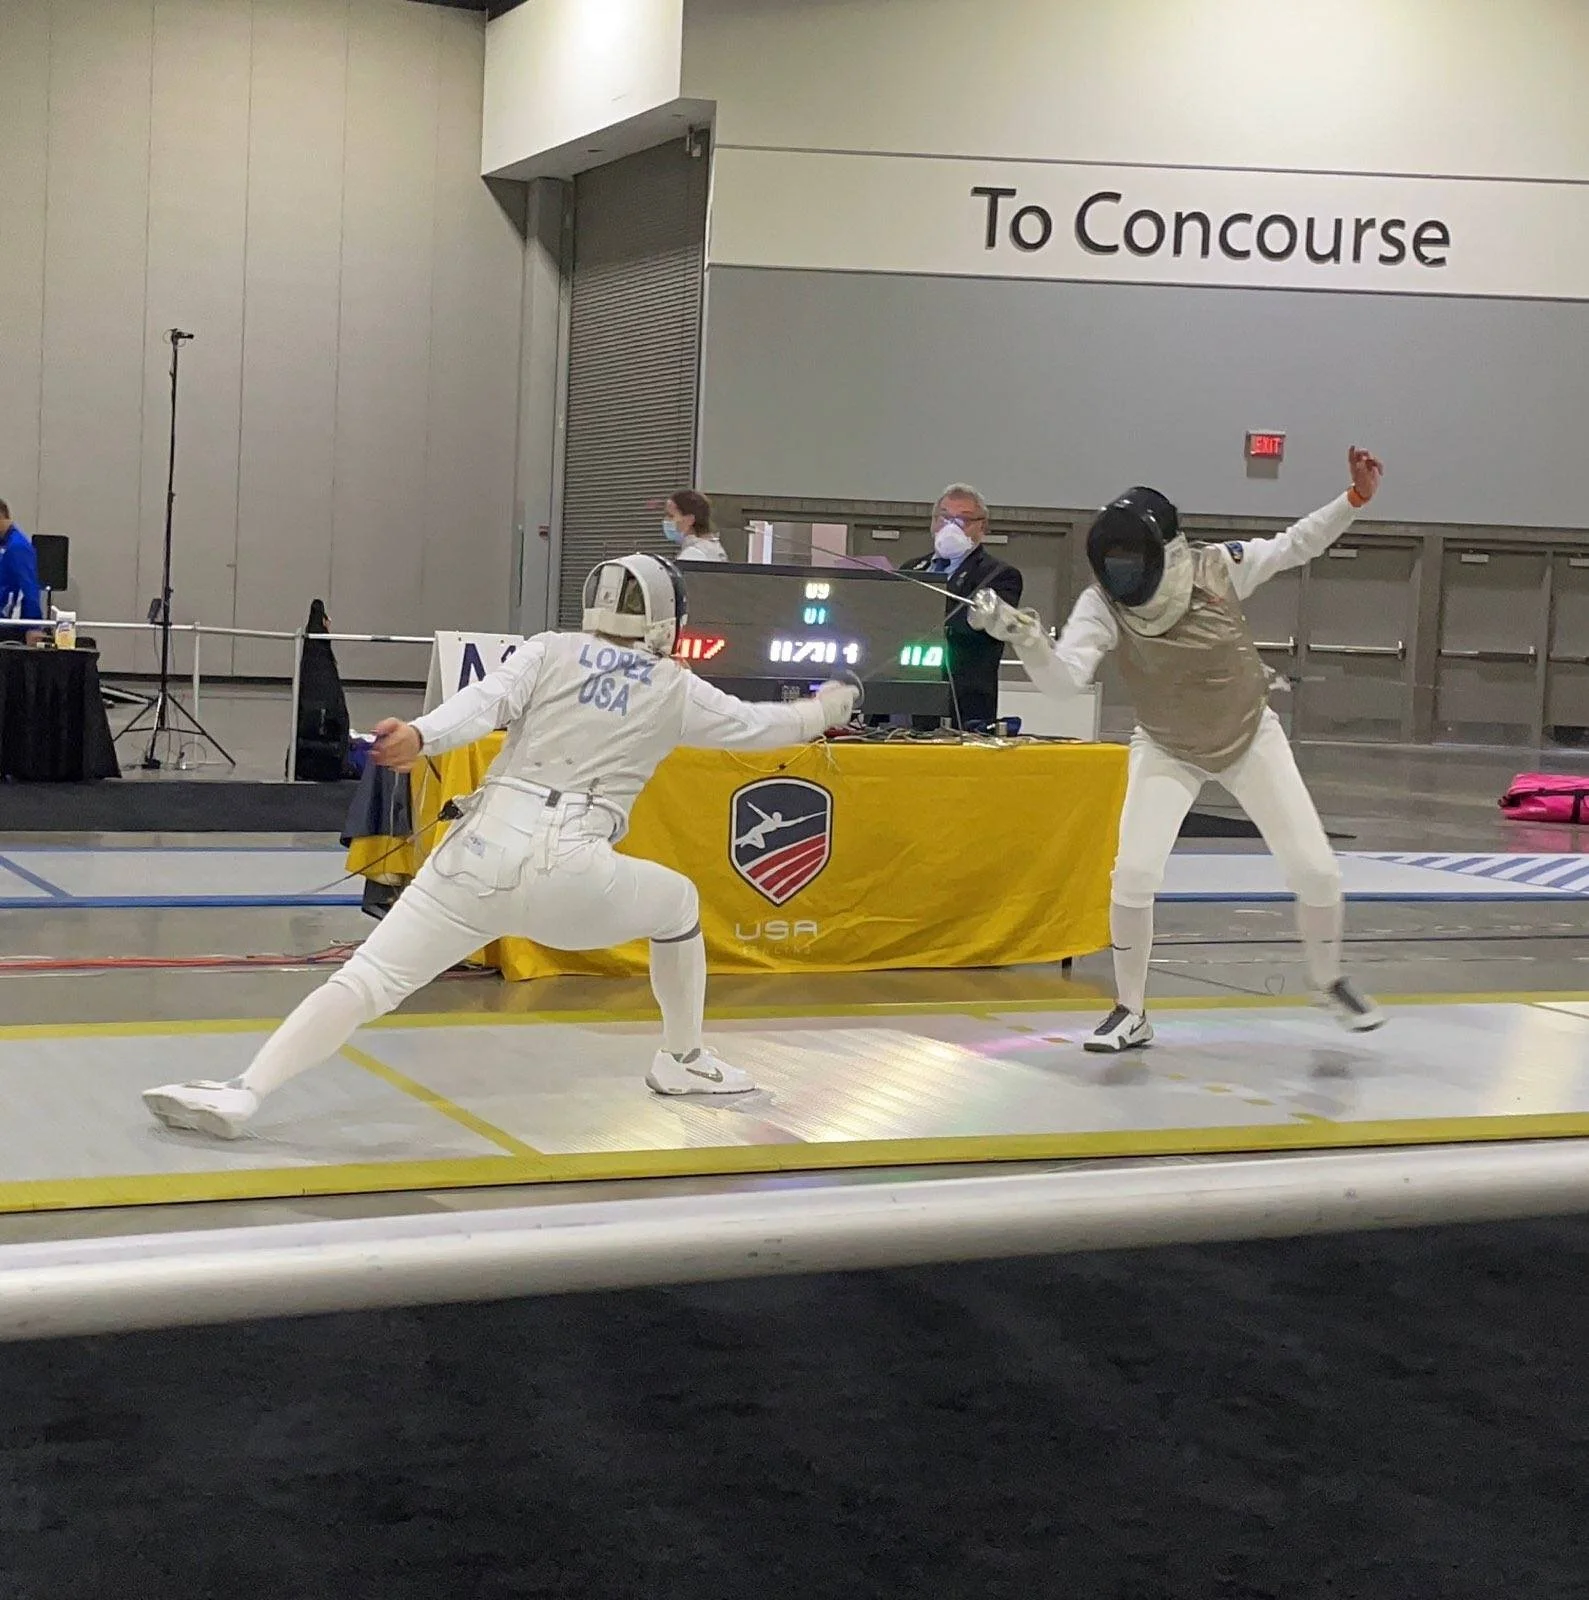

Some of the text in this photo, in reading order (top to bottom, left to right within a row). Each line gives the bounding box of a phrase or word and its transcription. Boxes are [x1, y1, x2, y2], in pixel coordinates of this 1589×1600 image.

[971, 187, 1450, 266] To Concourse
[1255, 436, 1281, 454] EXIT
[578, 644, 656, 685] LOPEZ
[578, 673, 630, 716] USA
[735, 919, 818, 941] USA
